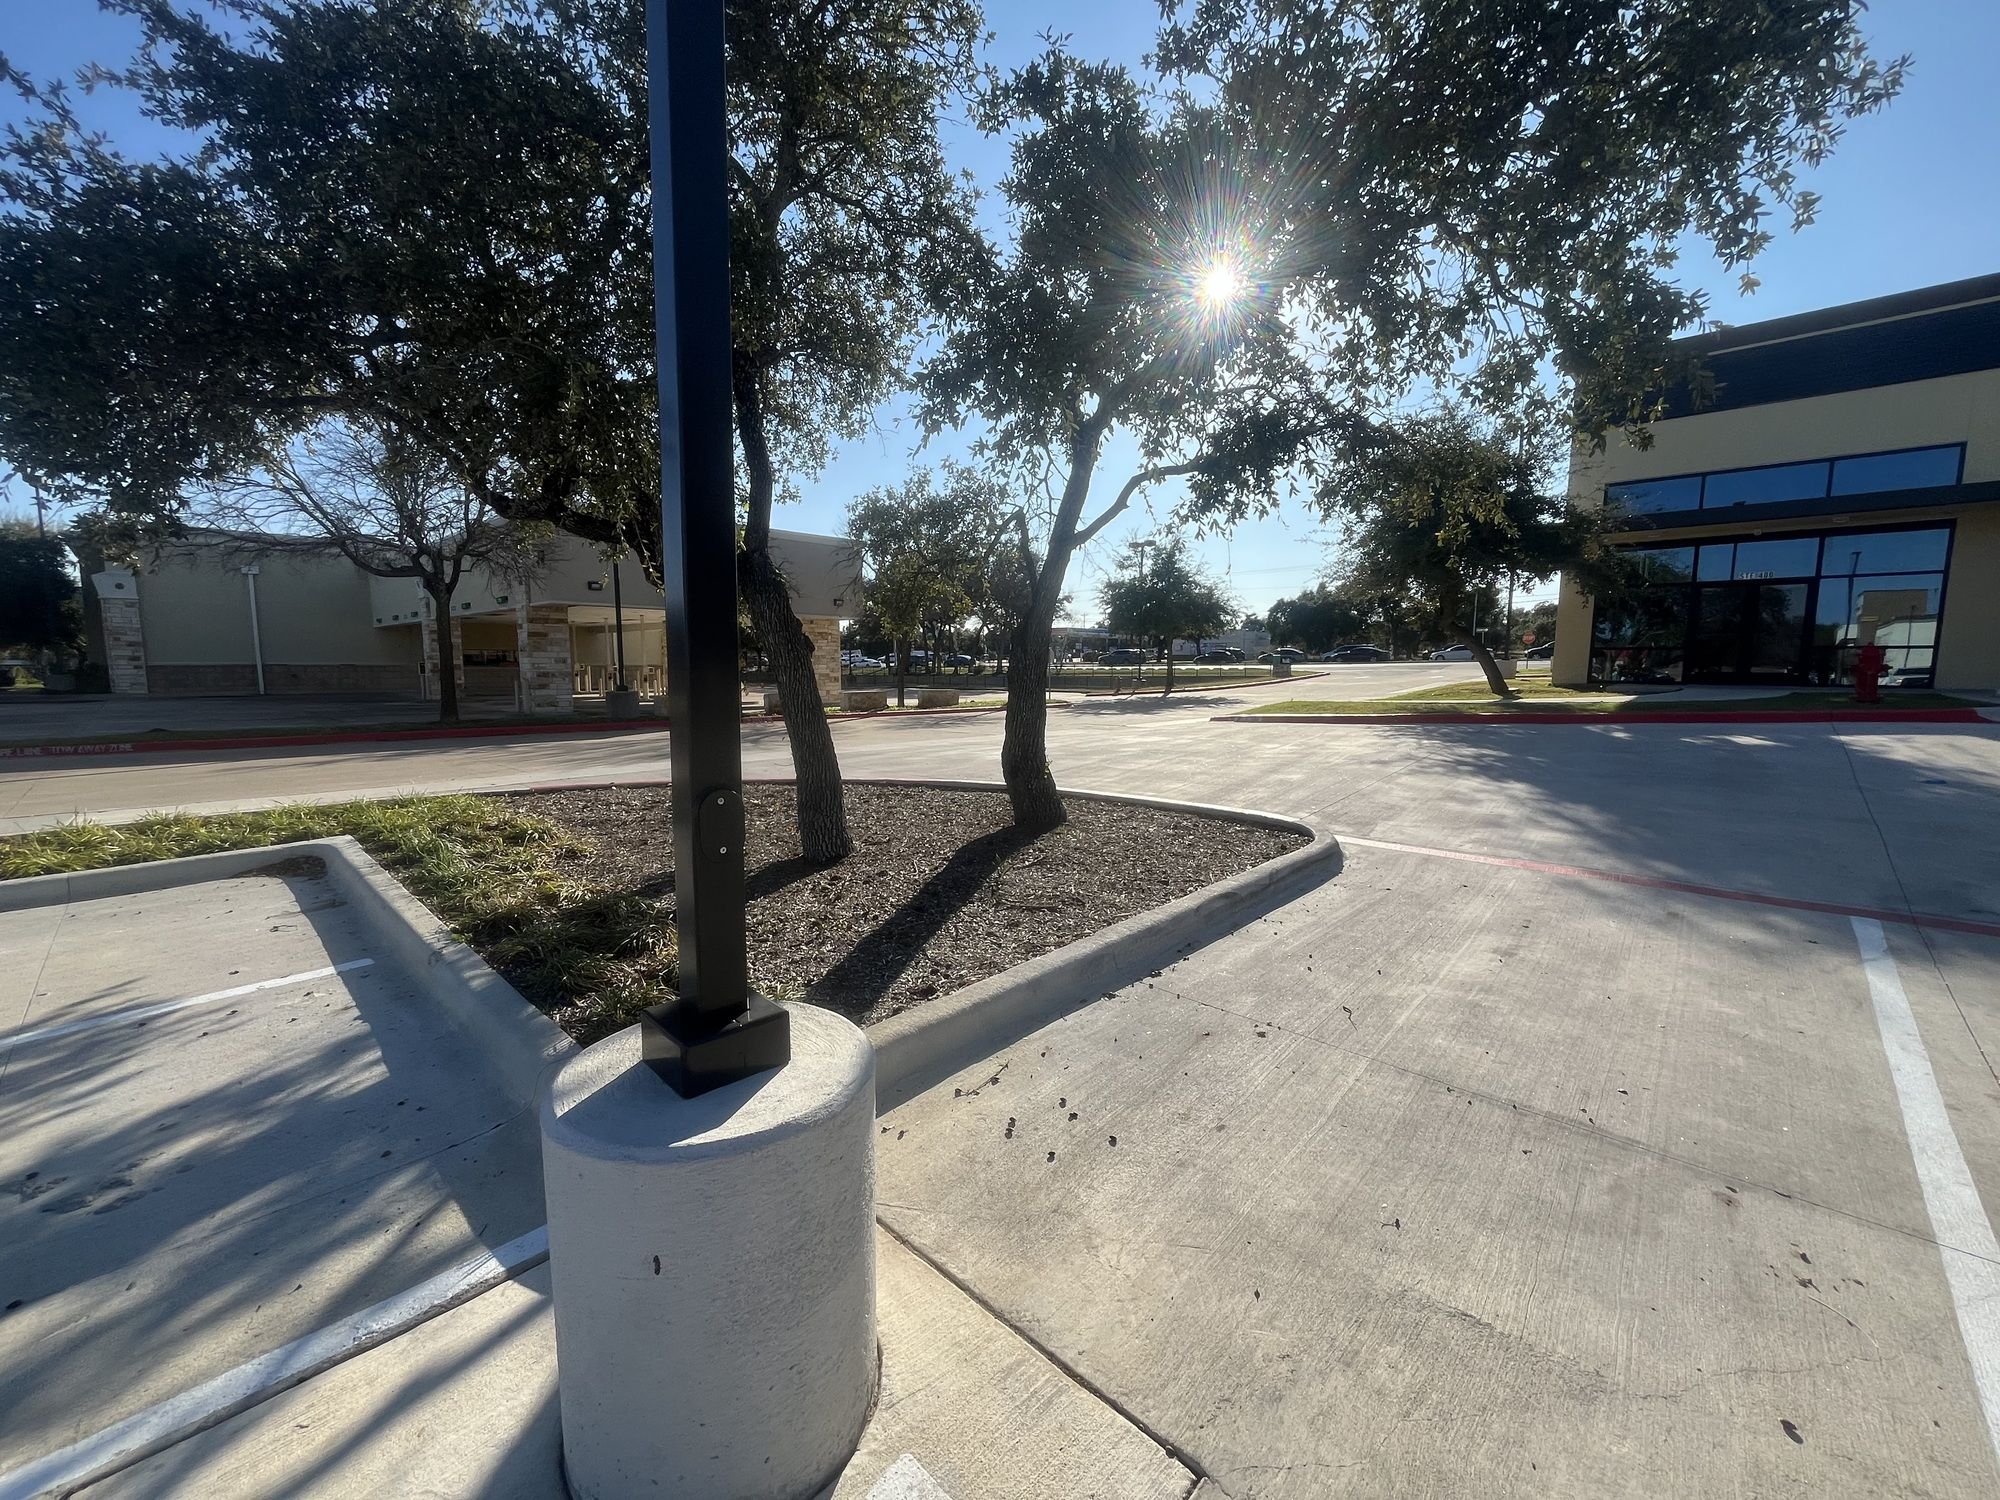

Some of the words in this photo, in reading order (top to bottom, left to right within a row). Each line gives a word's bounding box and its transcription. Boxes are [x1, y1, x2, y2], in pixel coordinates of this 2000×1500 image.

[1739, 571, 1754, 579] STE
[48, 746, 75, 755] TOW
[77, 745, 106, 754] AWAY
[107, 743, 133, 753] ZONE
